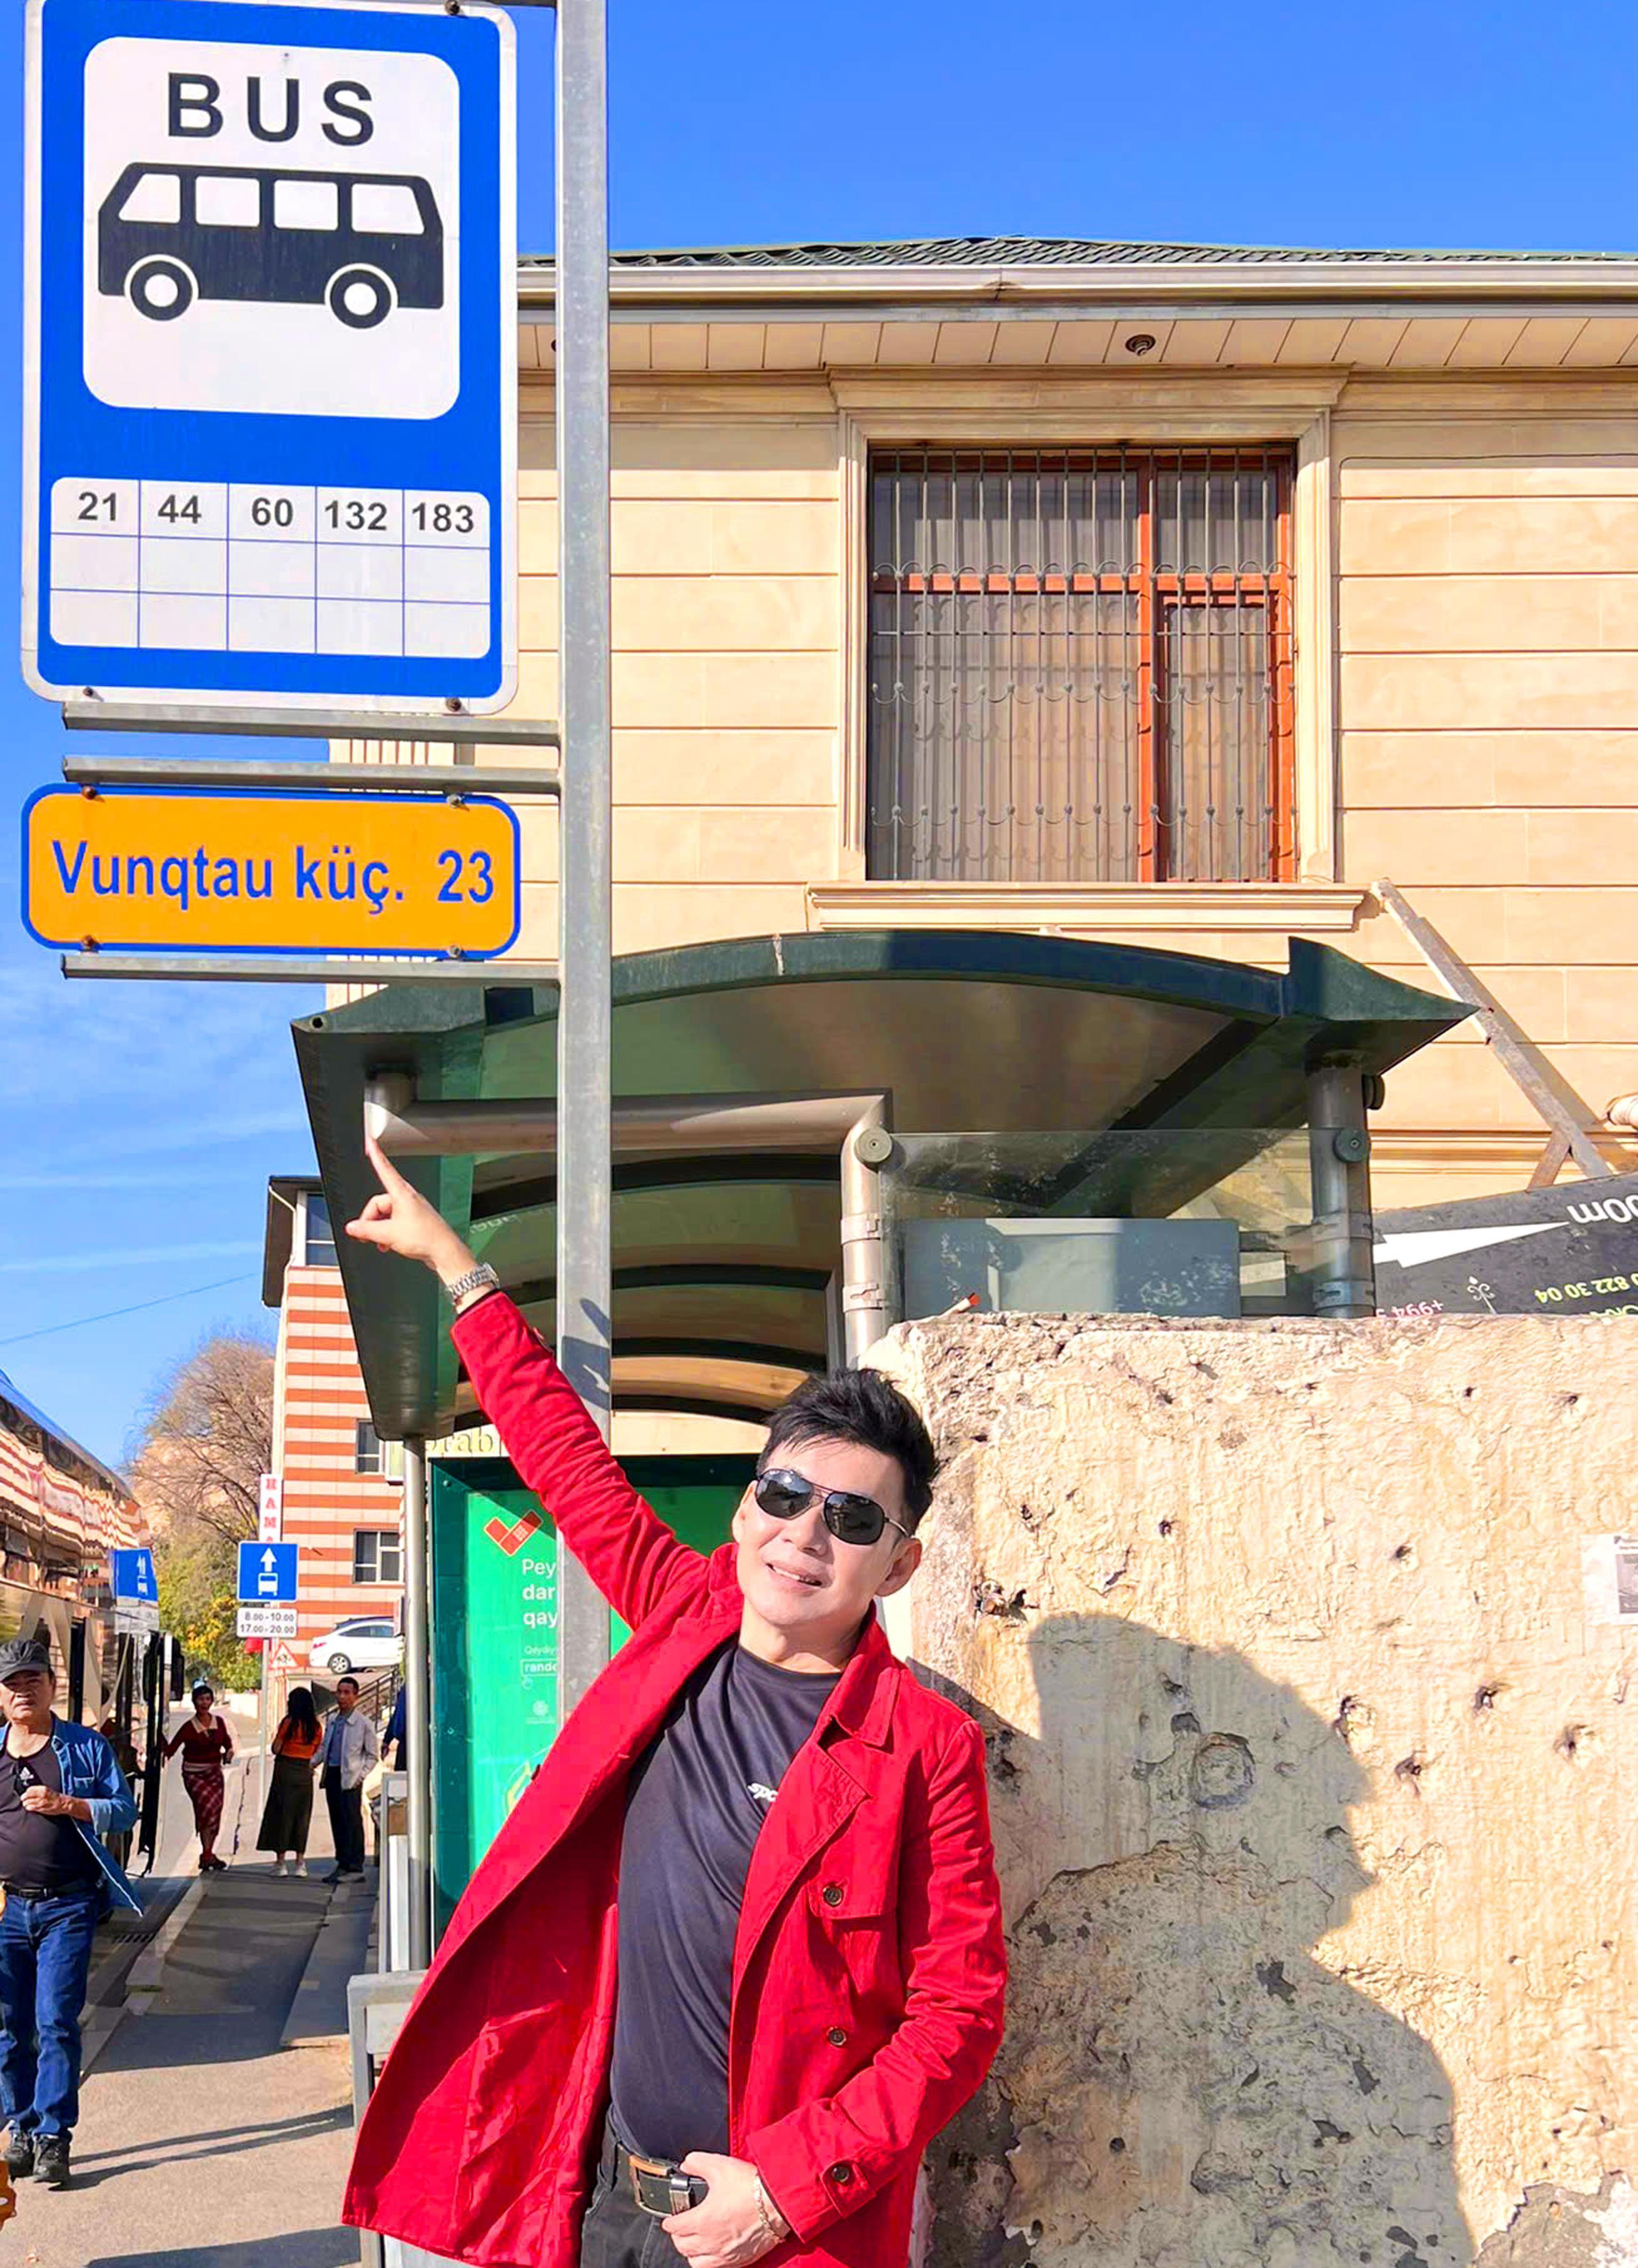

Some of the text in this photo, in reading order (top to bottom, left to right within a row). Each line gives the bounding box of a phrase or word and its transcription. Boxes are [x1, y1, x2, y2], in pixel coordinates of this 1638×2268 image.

[169, 73, 374, 146] BUS
[78, 492, 474, 533] 21 44 60 132 183
[52, 840, 494, 915] Vunqtau küç. 23
[1564, 1282, 1593, 1298] 30
[1591, 1276, 1631, 1293] 822
[1535, 1287, 1563, 1303] 04
[522, 1559, 556, 1579] Pey
[522, 1584, 556, 1600] dar
